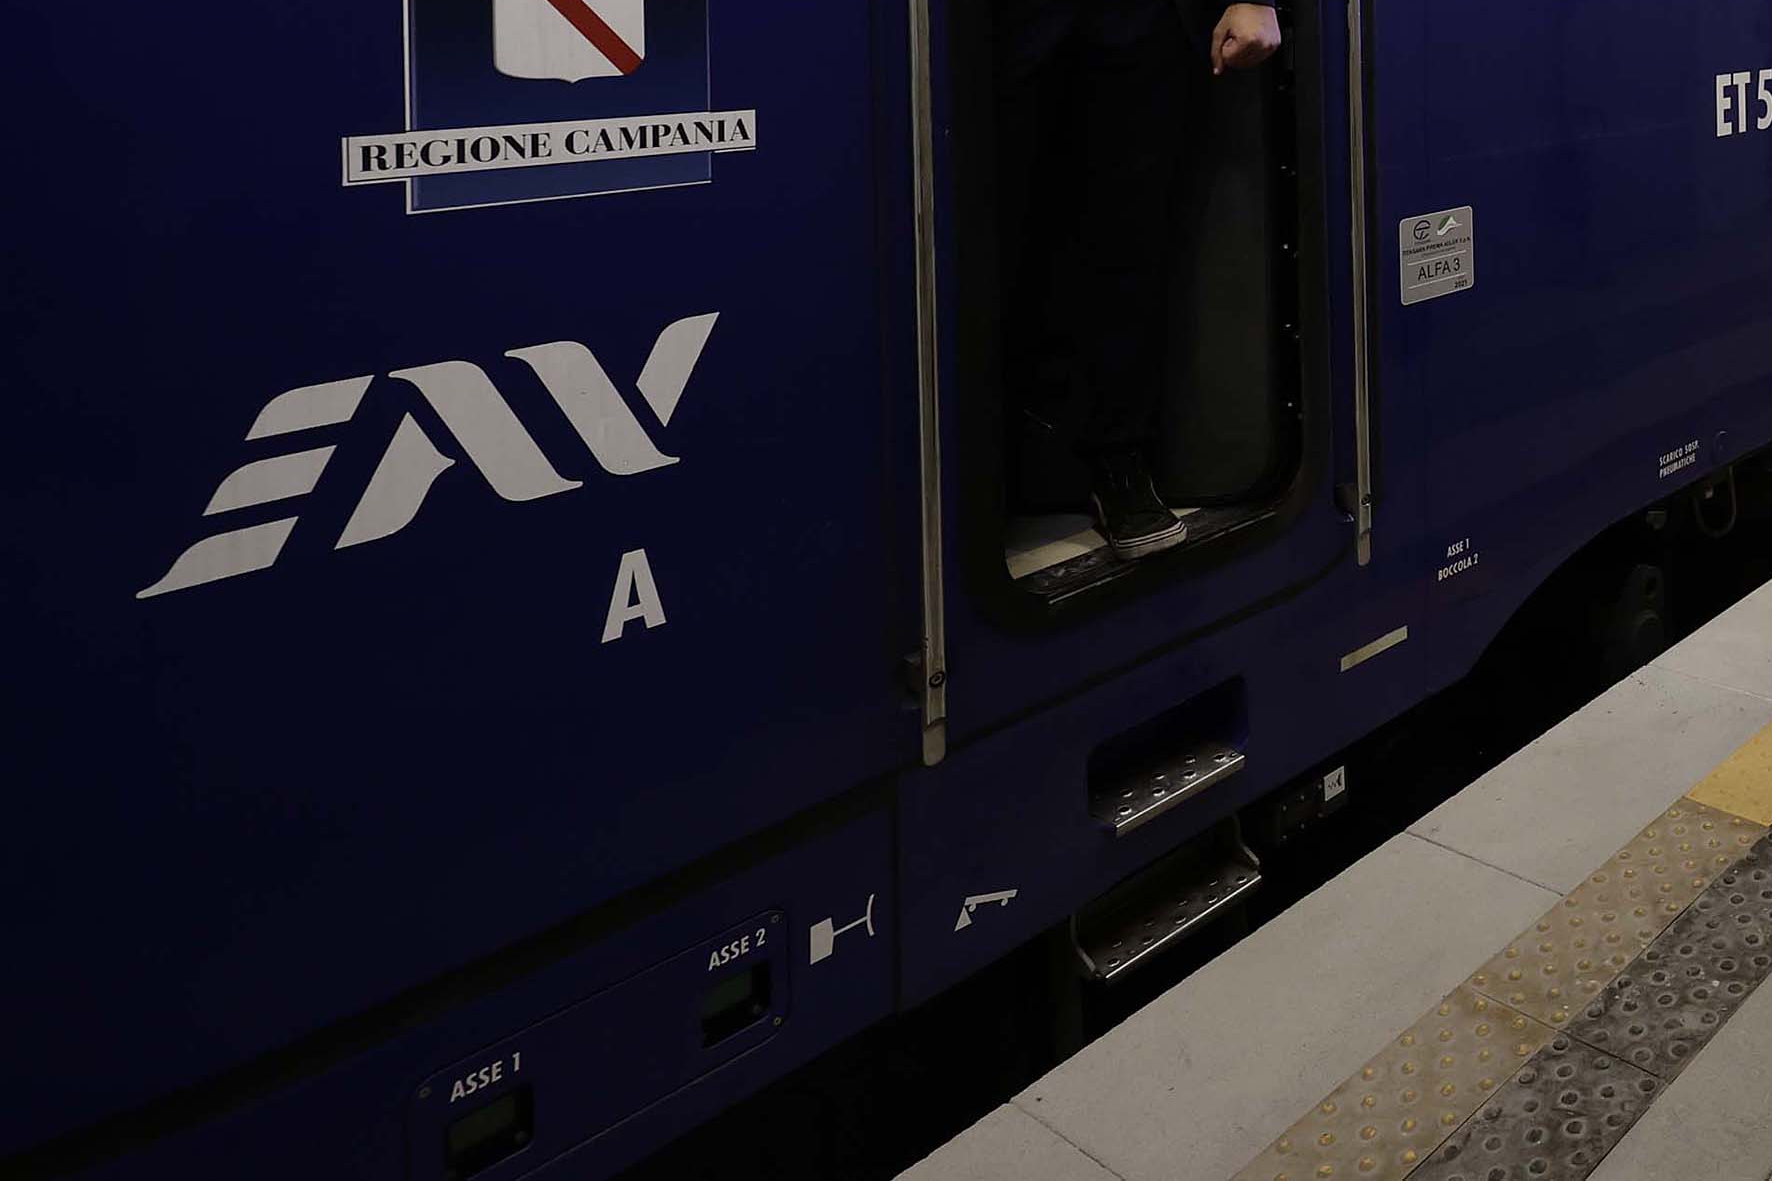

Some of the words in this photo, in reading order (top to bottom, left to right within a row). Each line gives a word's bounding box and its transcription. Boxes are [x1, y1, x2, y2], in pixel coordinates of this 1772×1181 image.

[1716, 71, 1751, 137] ET
[360, 133, 552, 173] REGIONE
[564, 118, 751, 156] CAMPANIA
[1418, 260, 1451, 280] ALFA
[1453, 257, 1461, 272] 3
[136, 312, 720, 599] EAV
[1438, 556, 1472, 582] BOCCOLA
[1473, 553, 1479, 565] 2
[1446, 540, 1464, 559] ASSE
[1465, 538, 1470, 549] 1
[602, 548, 667, 644] A
[708, 935, 750, 972] ASSE
[755, 927, 766, 947] 2
[450, 1060, 503, 1103] ASSE
[511, 1052, 521, 1072] 1
